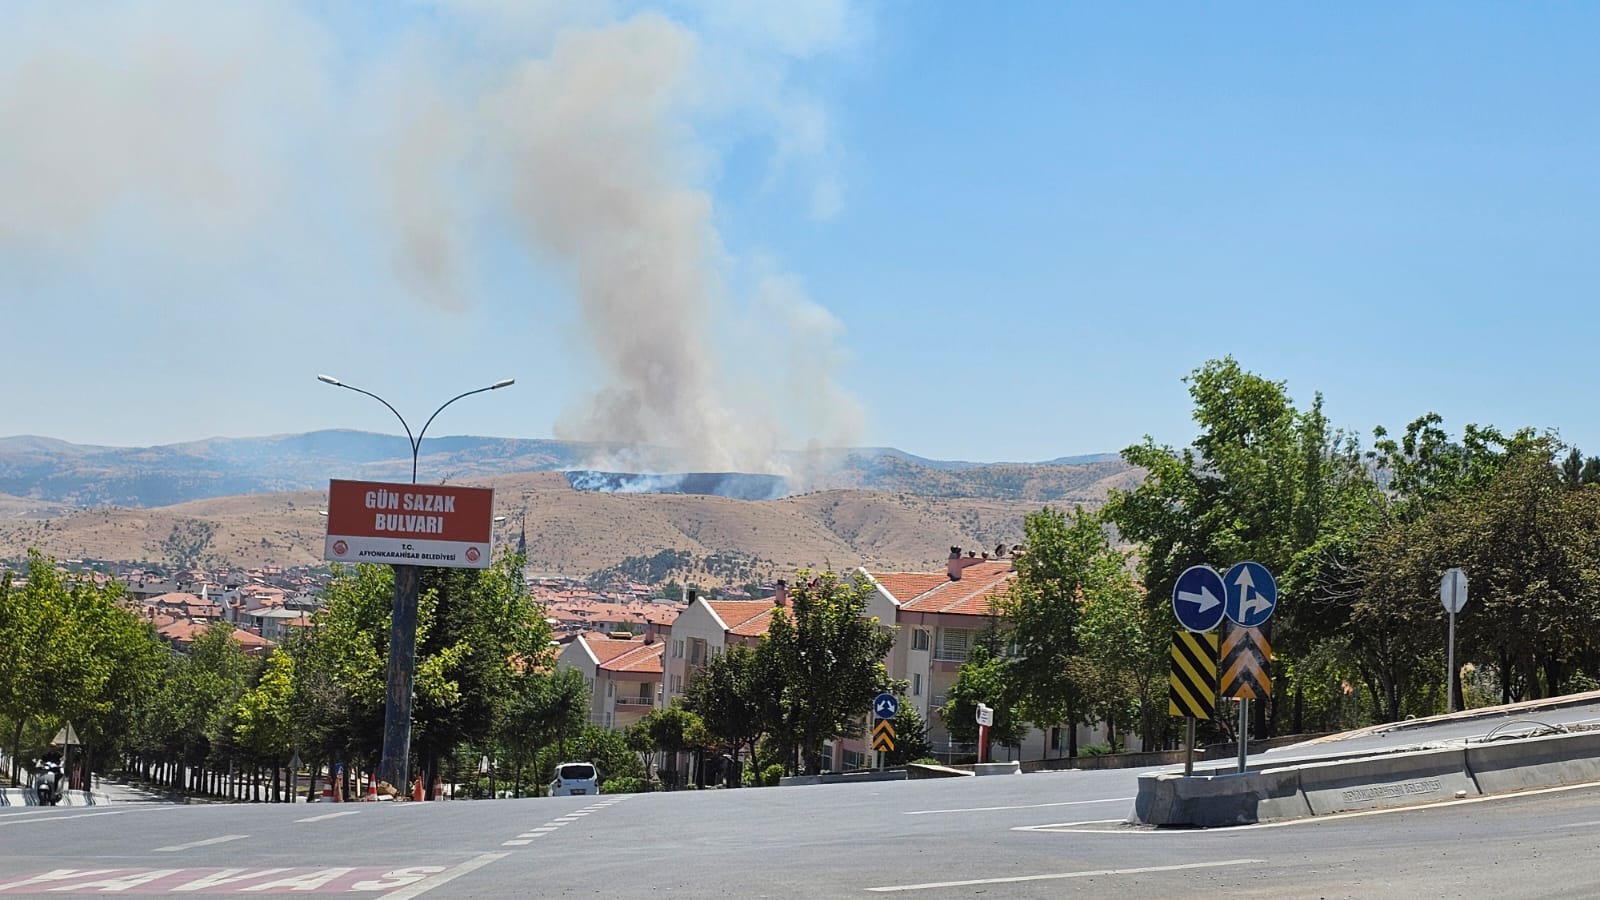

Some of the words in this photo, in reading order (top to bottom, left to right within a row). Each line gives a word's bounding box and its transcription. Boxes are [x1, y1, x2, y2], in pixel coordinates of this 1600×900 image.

[365, 488, 399, 510] GÜN
[403, 493, 456, 513] SAZAK
[375, 513, 444, 534] BULVARI
